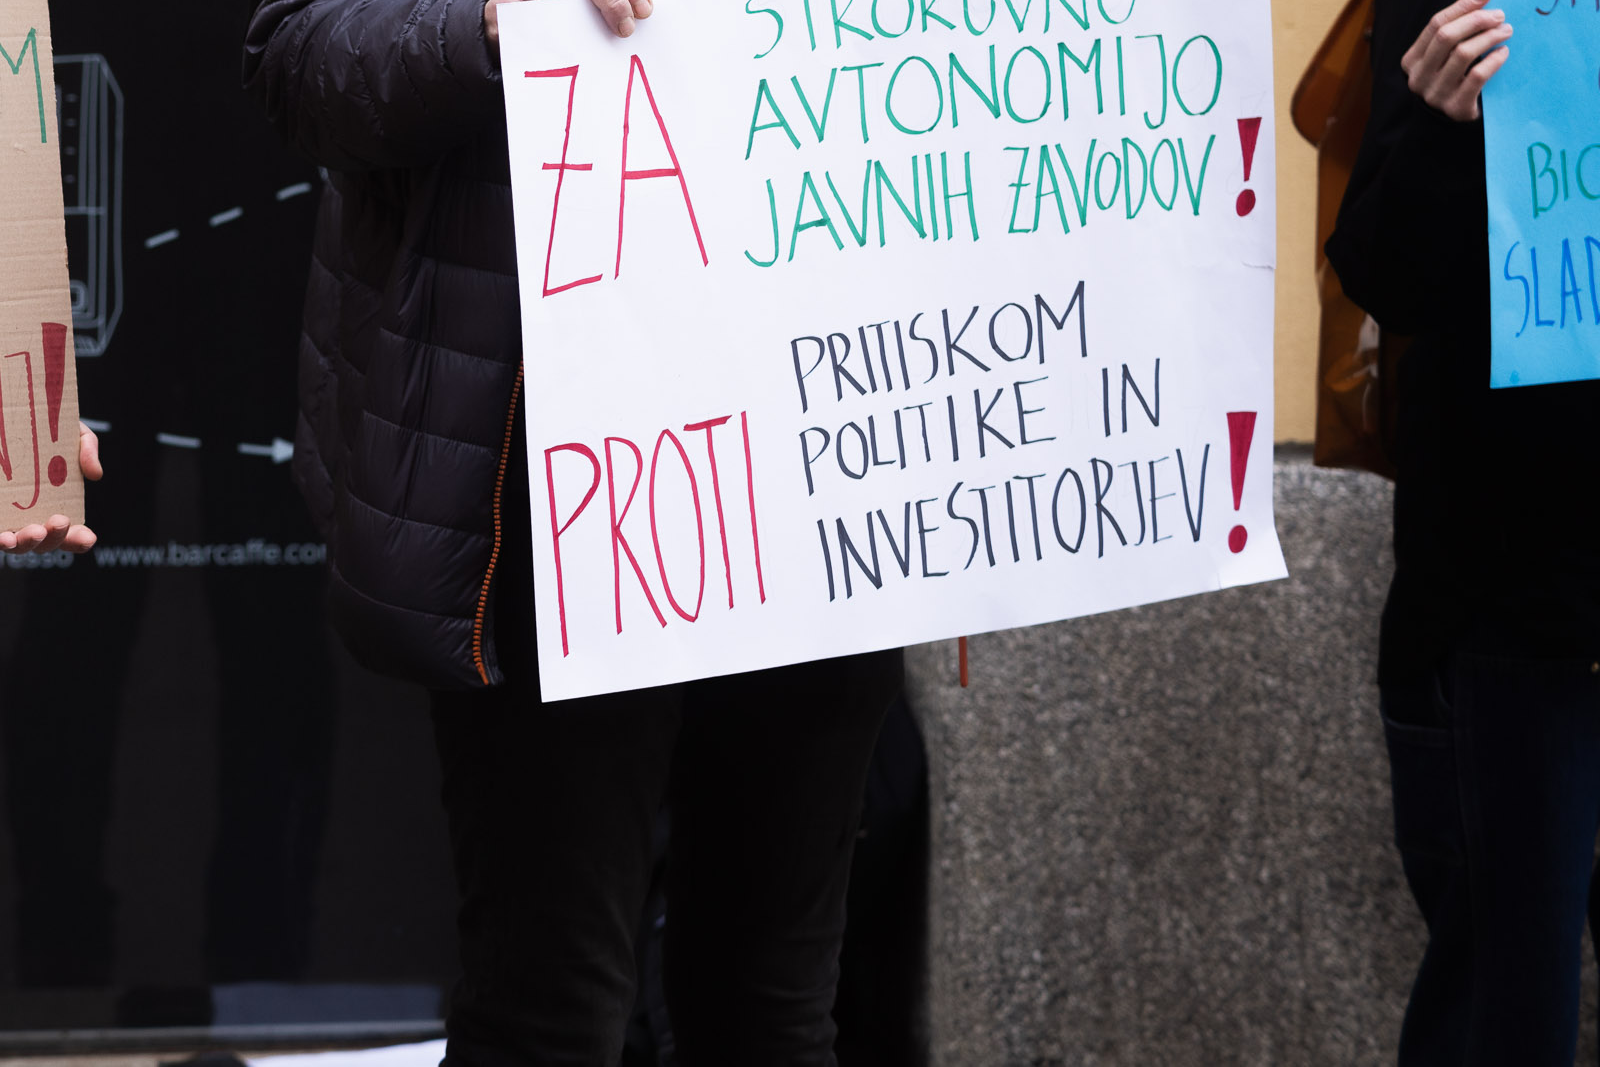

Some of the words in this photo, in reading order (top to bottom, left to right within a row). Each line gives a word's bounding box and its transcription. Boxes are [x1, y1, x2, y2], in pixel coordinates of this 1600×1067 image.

[744, 34, 1223, 160] AVTONOMIJO
[523, 54, 709, 298] ZA
[743, 151, 980, 268] JAVNIH
[791, 281, 1088, 412] PRITISKOM
[798, 375, 1055, 496] POLITIKE
[1101, 357, 1161, 438] IN
[544, 411, 765, 657] PROTI
